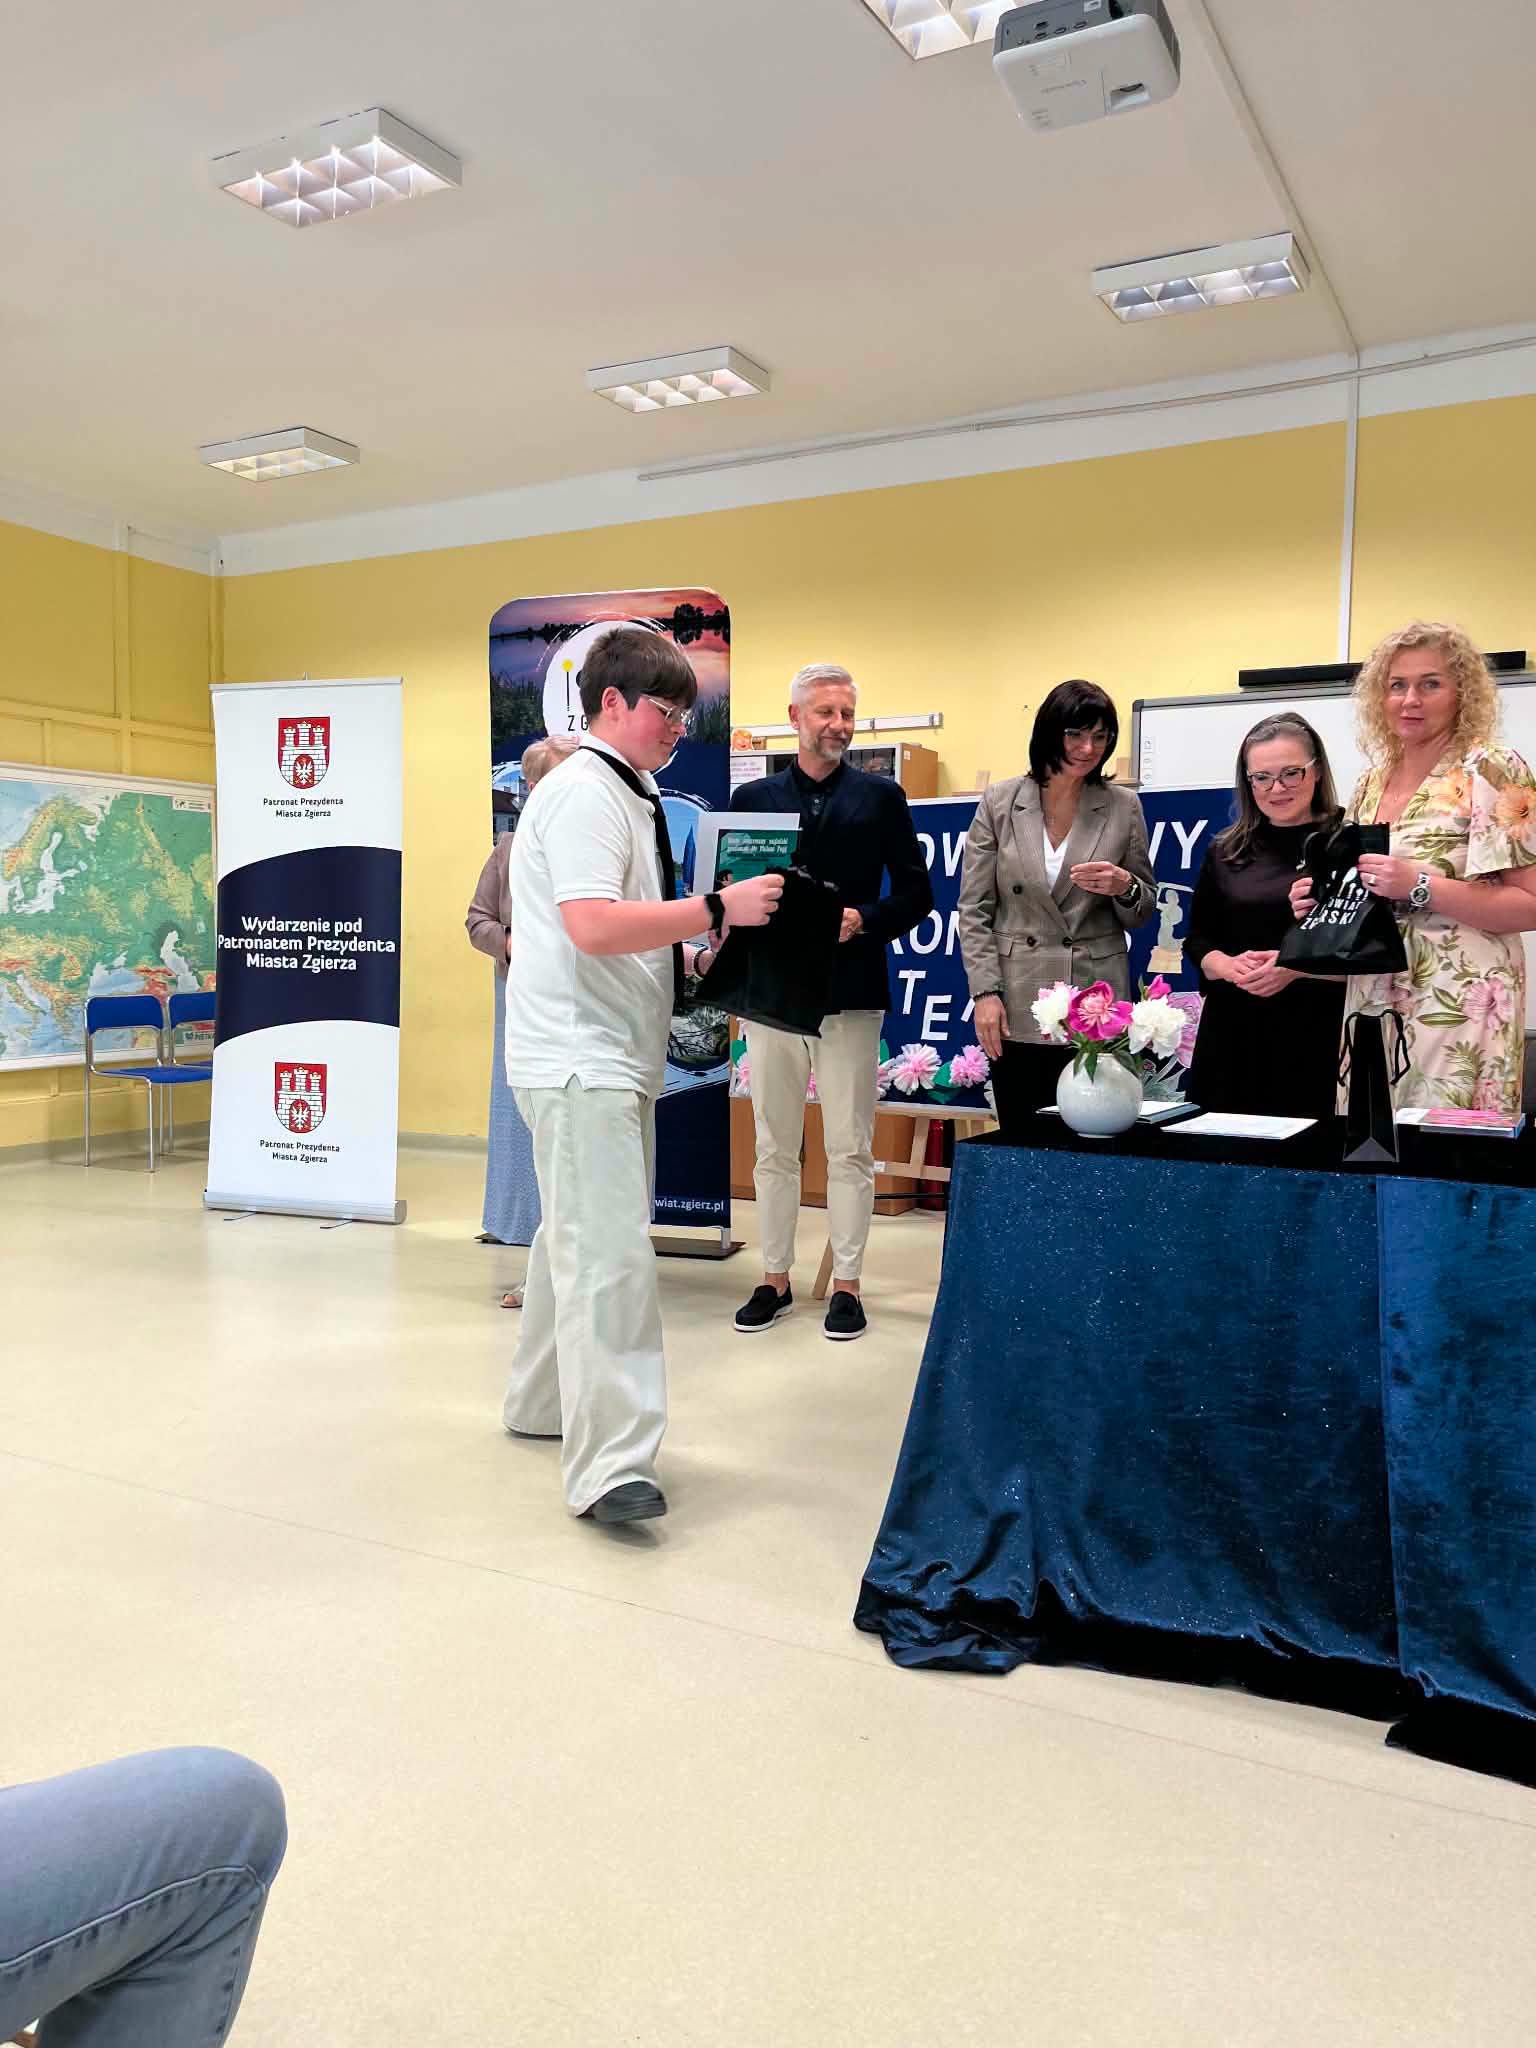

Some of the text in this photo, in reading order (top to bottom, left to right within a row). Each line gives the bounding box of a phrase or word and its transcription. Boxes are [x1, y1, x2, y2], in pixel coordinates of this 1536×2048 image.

[263, 797, 344, 807] Patronat Prezydenta
[275, 809, 331, 819] Miasta Zgierza
[241, 916, 363, 936] Wydarzenie pod
[217, 934, 396, 956] Patronatem Prezydenta
[246, 953, 357, 974] Miasta Zgierza
[259, 1139, 340, 1152] Patronat Prezydenta
[272, 1152, 328, 1164] Miasta Zgierza
